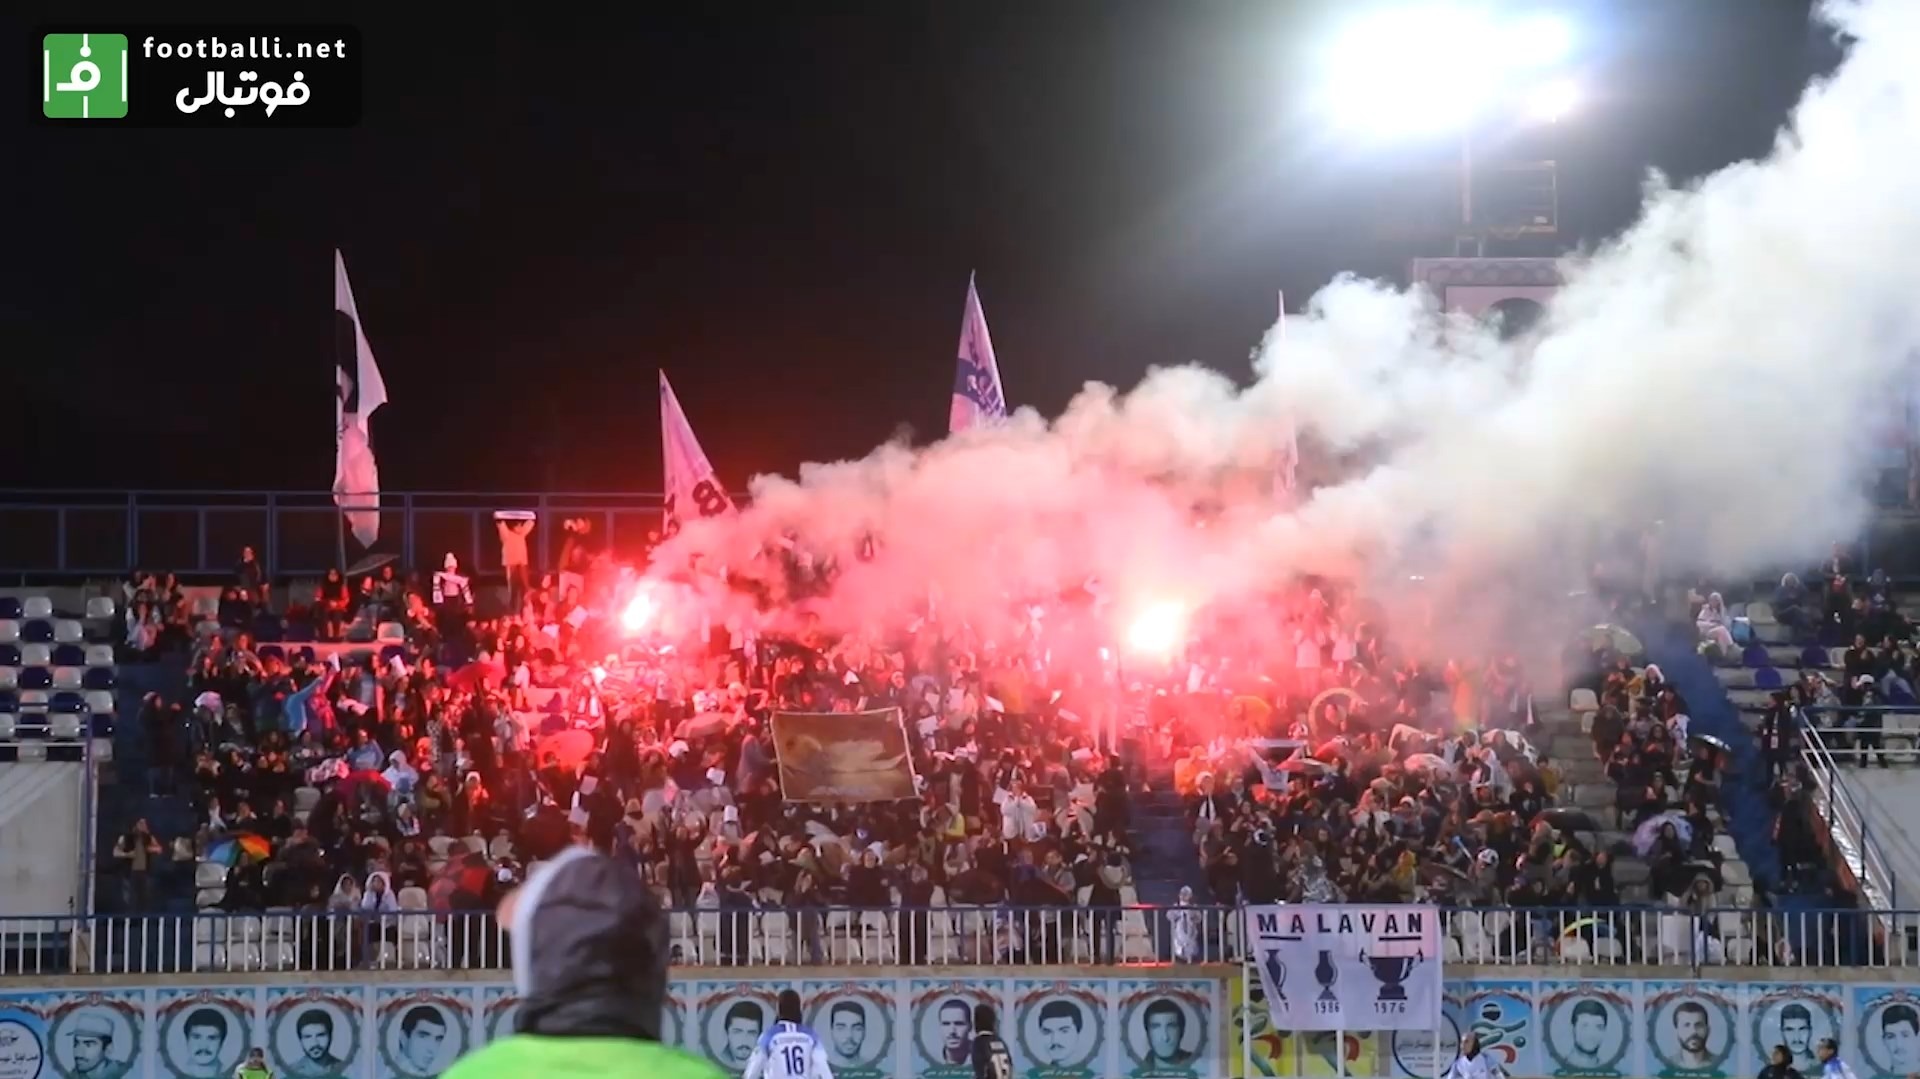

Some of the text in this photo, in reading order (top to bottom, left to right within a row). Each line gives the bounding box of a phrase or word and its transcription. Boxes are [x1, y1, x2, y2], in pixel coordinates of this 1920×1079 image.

[1257, 913, 1422, 933] MALAVAN
[1315, 1001, 1339, 1014] 1986
[1374, 1002, 1406, 1014] 1976
[780, 1045, 804, 1075] 16
